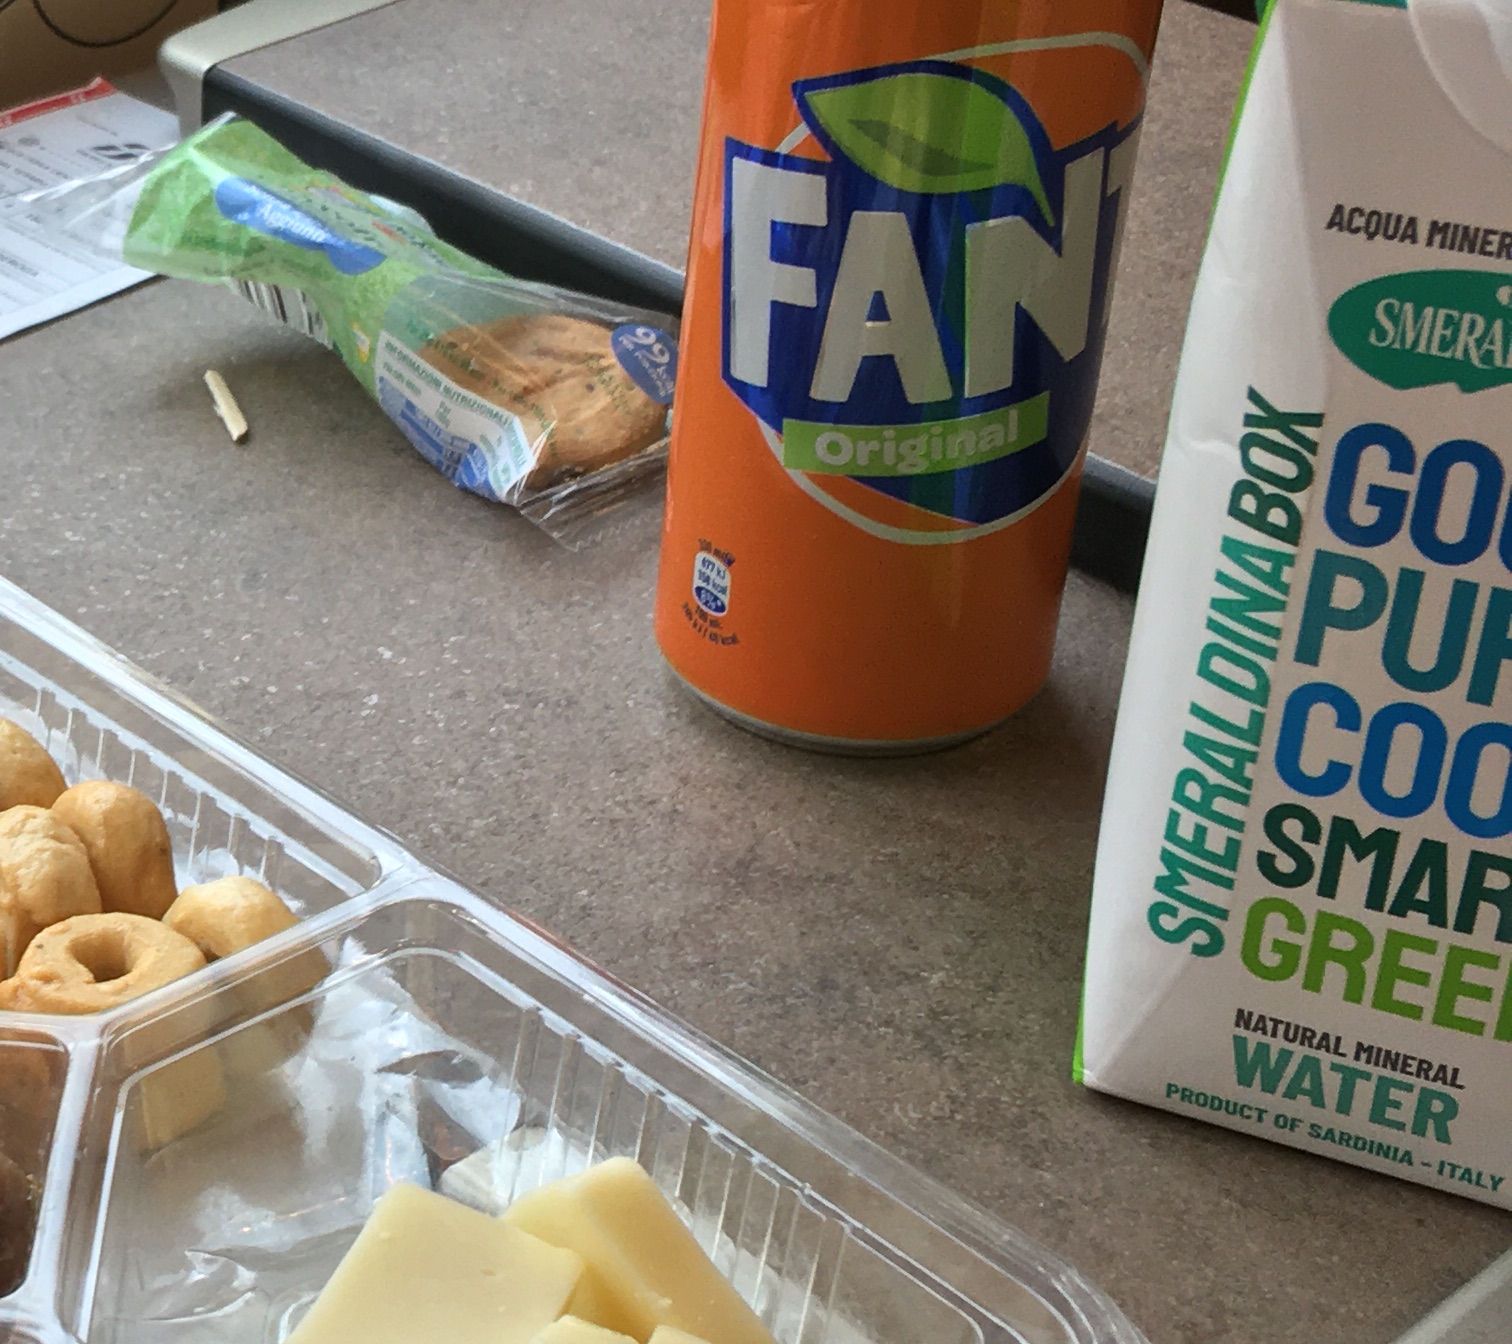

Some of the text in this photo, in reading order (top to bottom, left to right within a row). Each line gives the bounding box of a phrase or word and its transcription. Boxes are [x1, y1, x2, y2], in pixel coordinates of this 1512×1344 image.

[1324, 203, 1418, 246] ACQUA
[618, 326, 670, 364] 99
[1368, 297, 1512, 370] SMERA
[815, 409, 1019, 474] Original
[1323, 422, 1512, 575] GO
[1240, 896, 1512, 1042] GREE
[1232, 1034, 1460, 1145] WATER
[1234, 1007, 1466, 1090] NATURAL MINERAL
[1165, 1081, 1268, 1124] PRODUCT
[1274, 1112, 1304, 1133] OF
[1307, 1123, 1414, 1167] SARDINIA
[1437, 1159, 1505, 1193] ITALY
